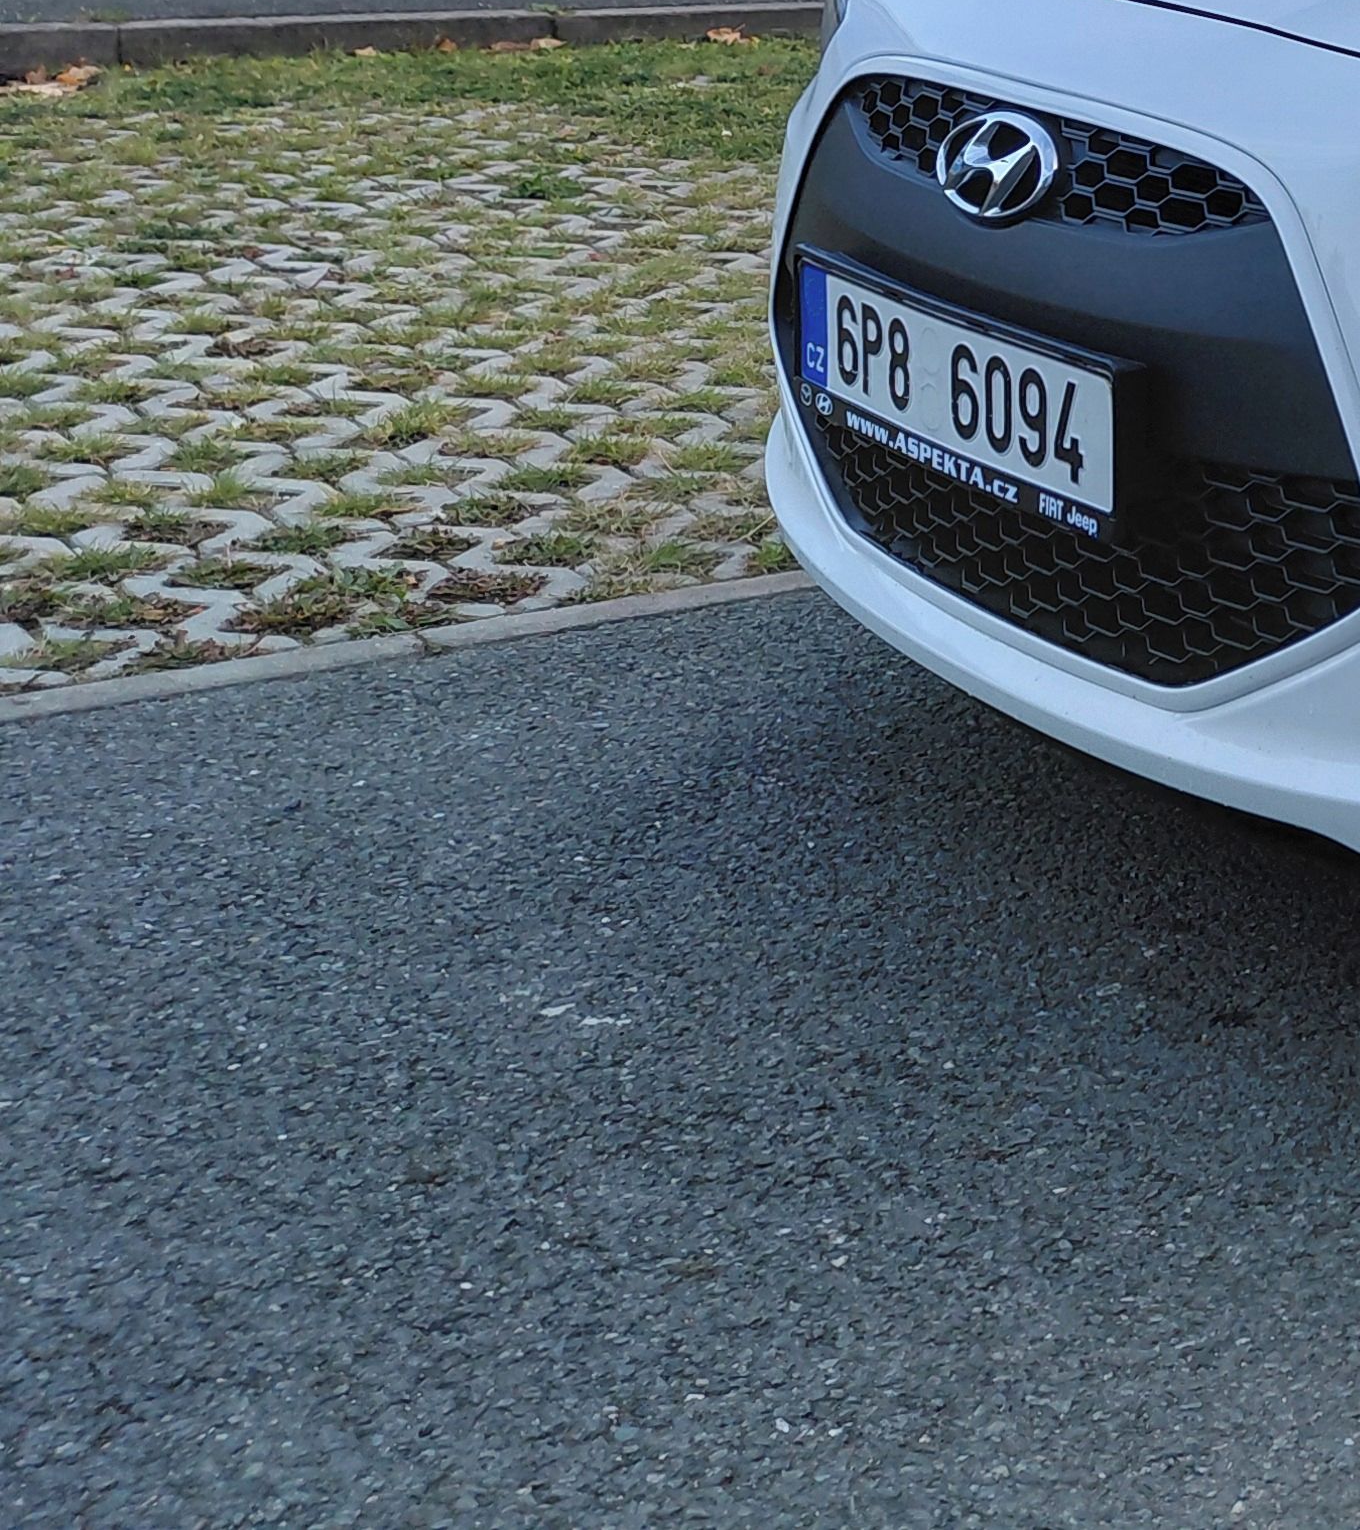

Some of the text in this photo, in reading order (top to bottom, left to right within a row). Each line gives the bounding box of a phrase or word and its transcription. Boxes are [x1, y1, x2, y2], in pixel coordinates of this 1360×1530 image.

[805, 341, 826, 374] CZ
[836, 294, 1087, 486] 6P8 6094
[1038, 492, 1099, 537] FIAT Jeep
